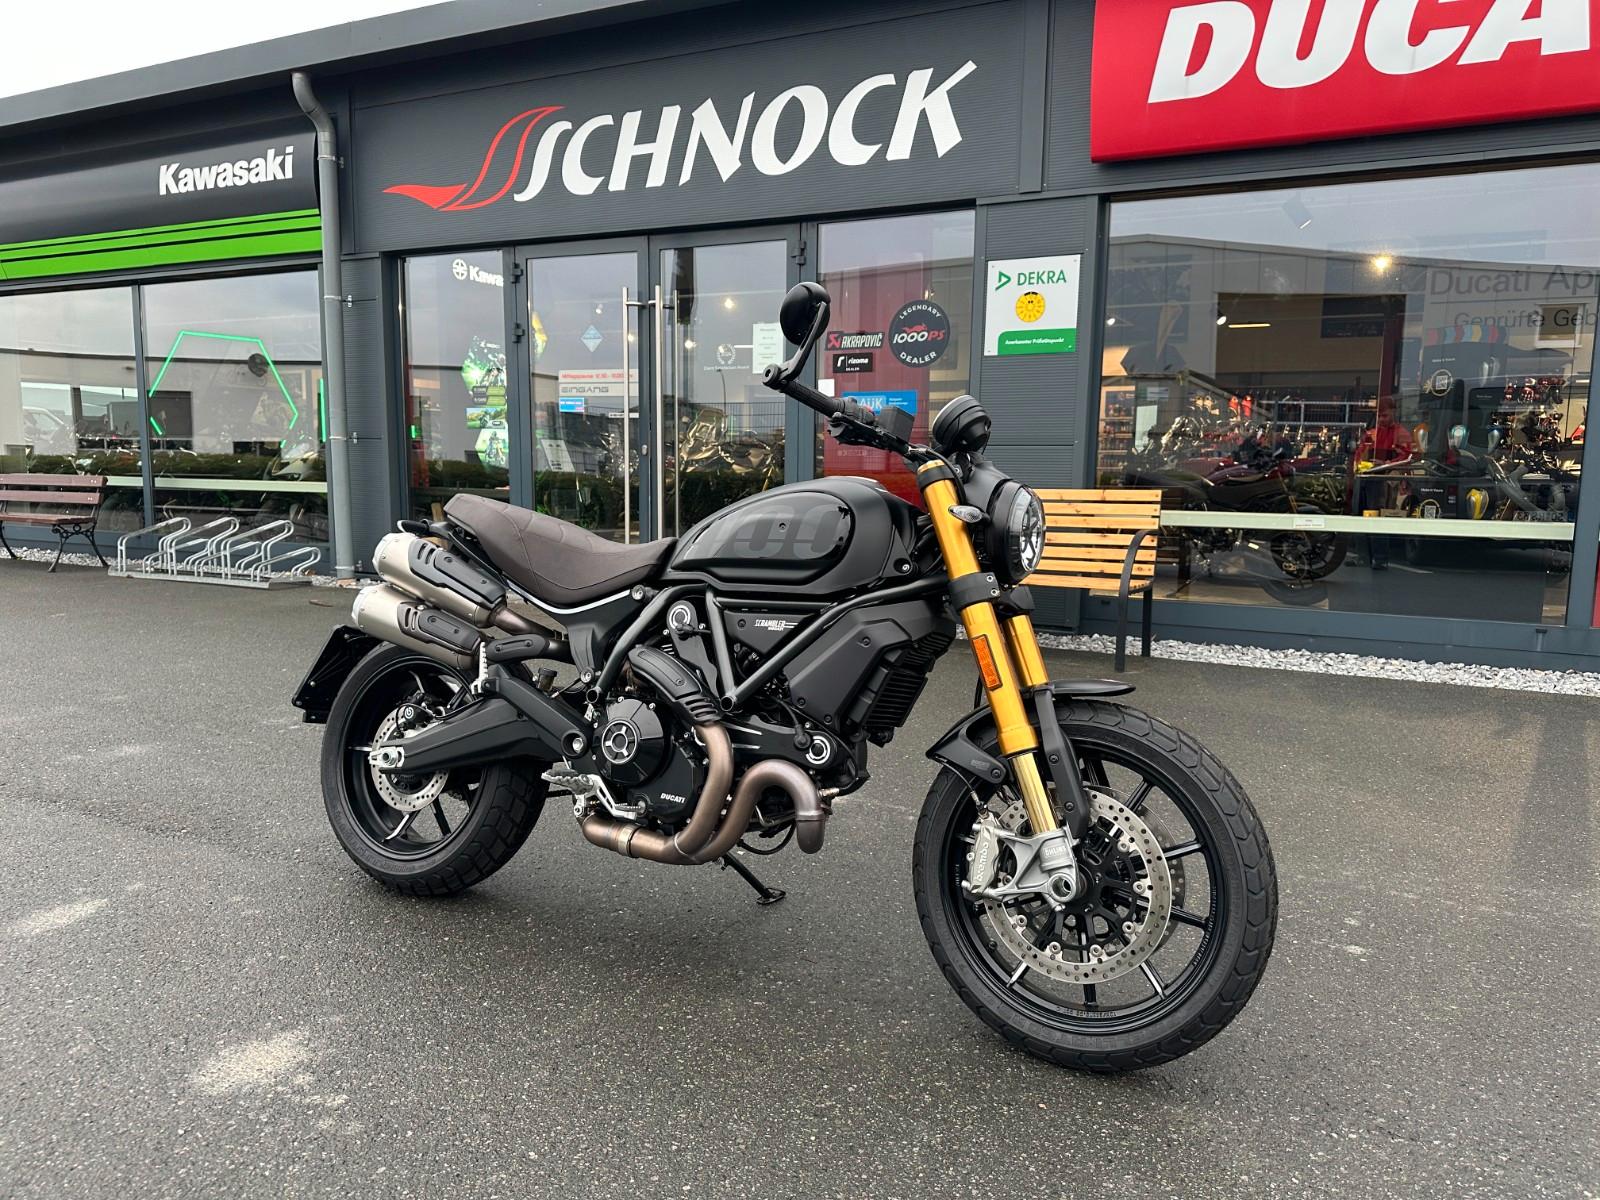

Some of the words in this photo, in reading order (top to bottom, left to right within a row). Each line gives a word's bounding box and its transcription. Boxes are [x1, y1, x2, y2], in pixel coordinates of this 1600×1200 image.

[513, 60, 978, 202] SCHNOCK
[159, 145, 293, 196] Kawasaki
[1017, 270, 1067, 286] DEKRA
[1430, 266, 1531, 296] Ducati
[899, 304, 942, 320] LEGENDARY
[892, 330, 946, 344] 1000PS
[899, 351, 938, 364] DEALER
[755, 619, 786, 628] SCRAMBLER
[660, 792, 685, 804] DUCATI
[976, 842, 989, 882] brembo
